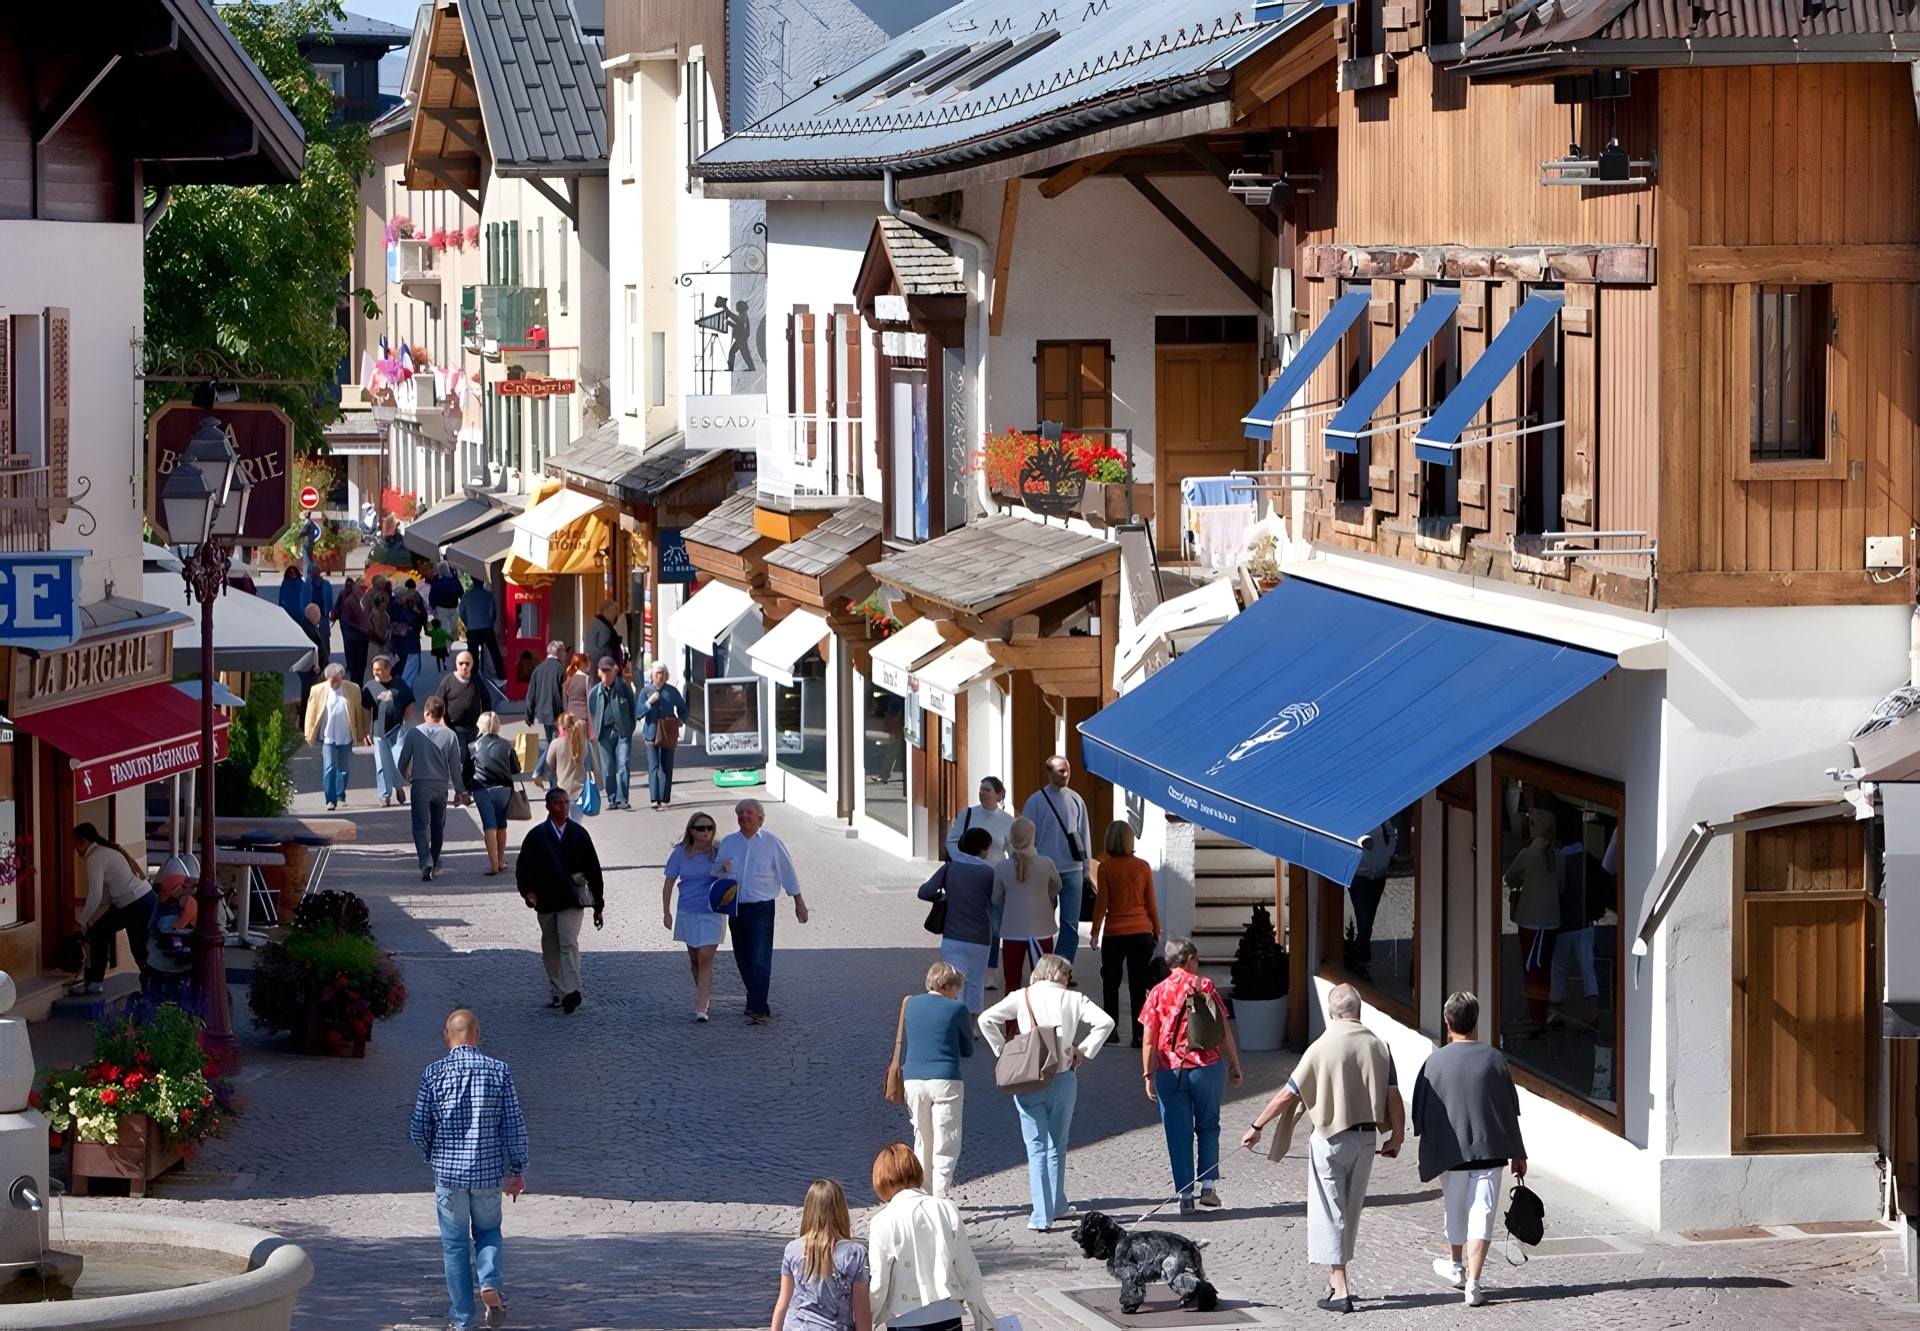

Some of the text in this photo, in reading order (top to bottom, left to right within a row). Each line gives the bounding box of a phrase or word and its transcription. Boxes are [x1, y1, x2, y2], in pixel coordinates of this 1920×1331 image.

[158, 448, 284, 483] BRIE
[33, 633, 154, 698] LA BERGERIE
